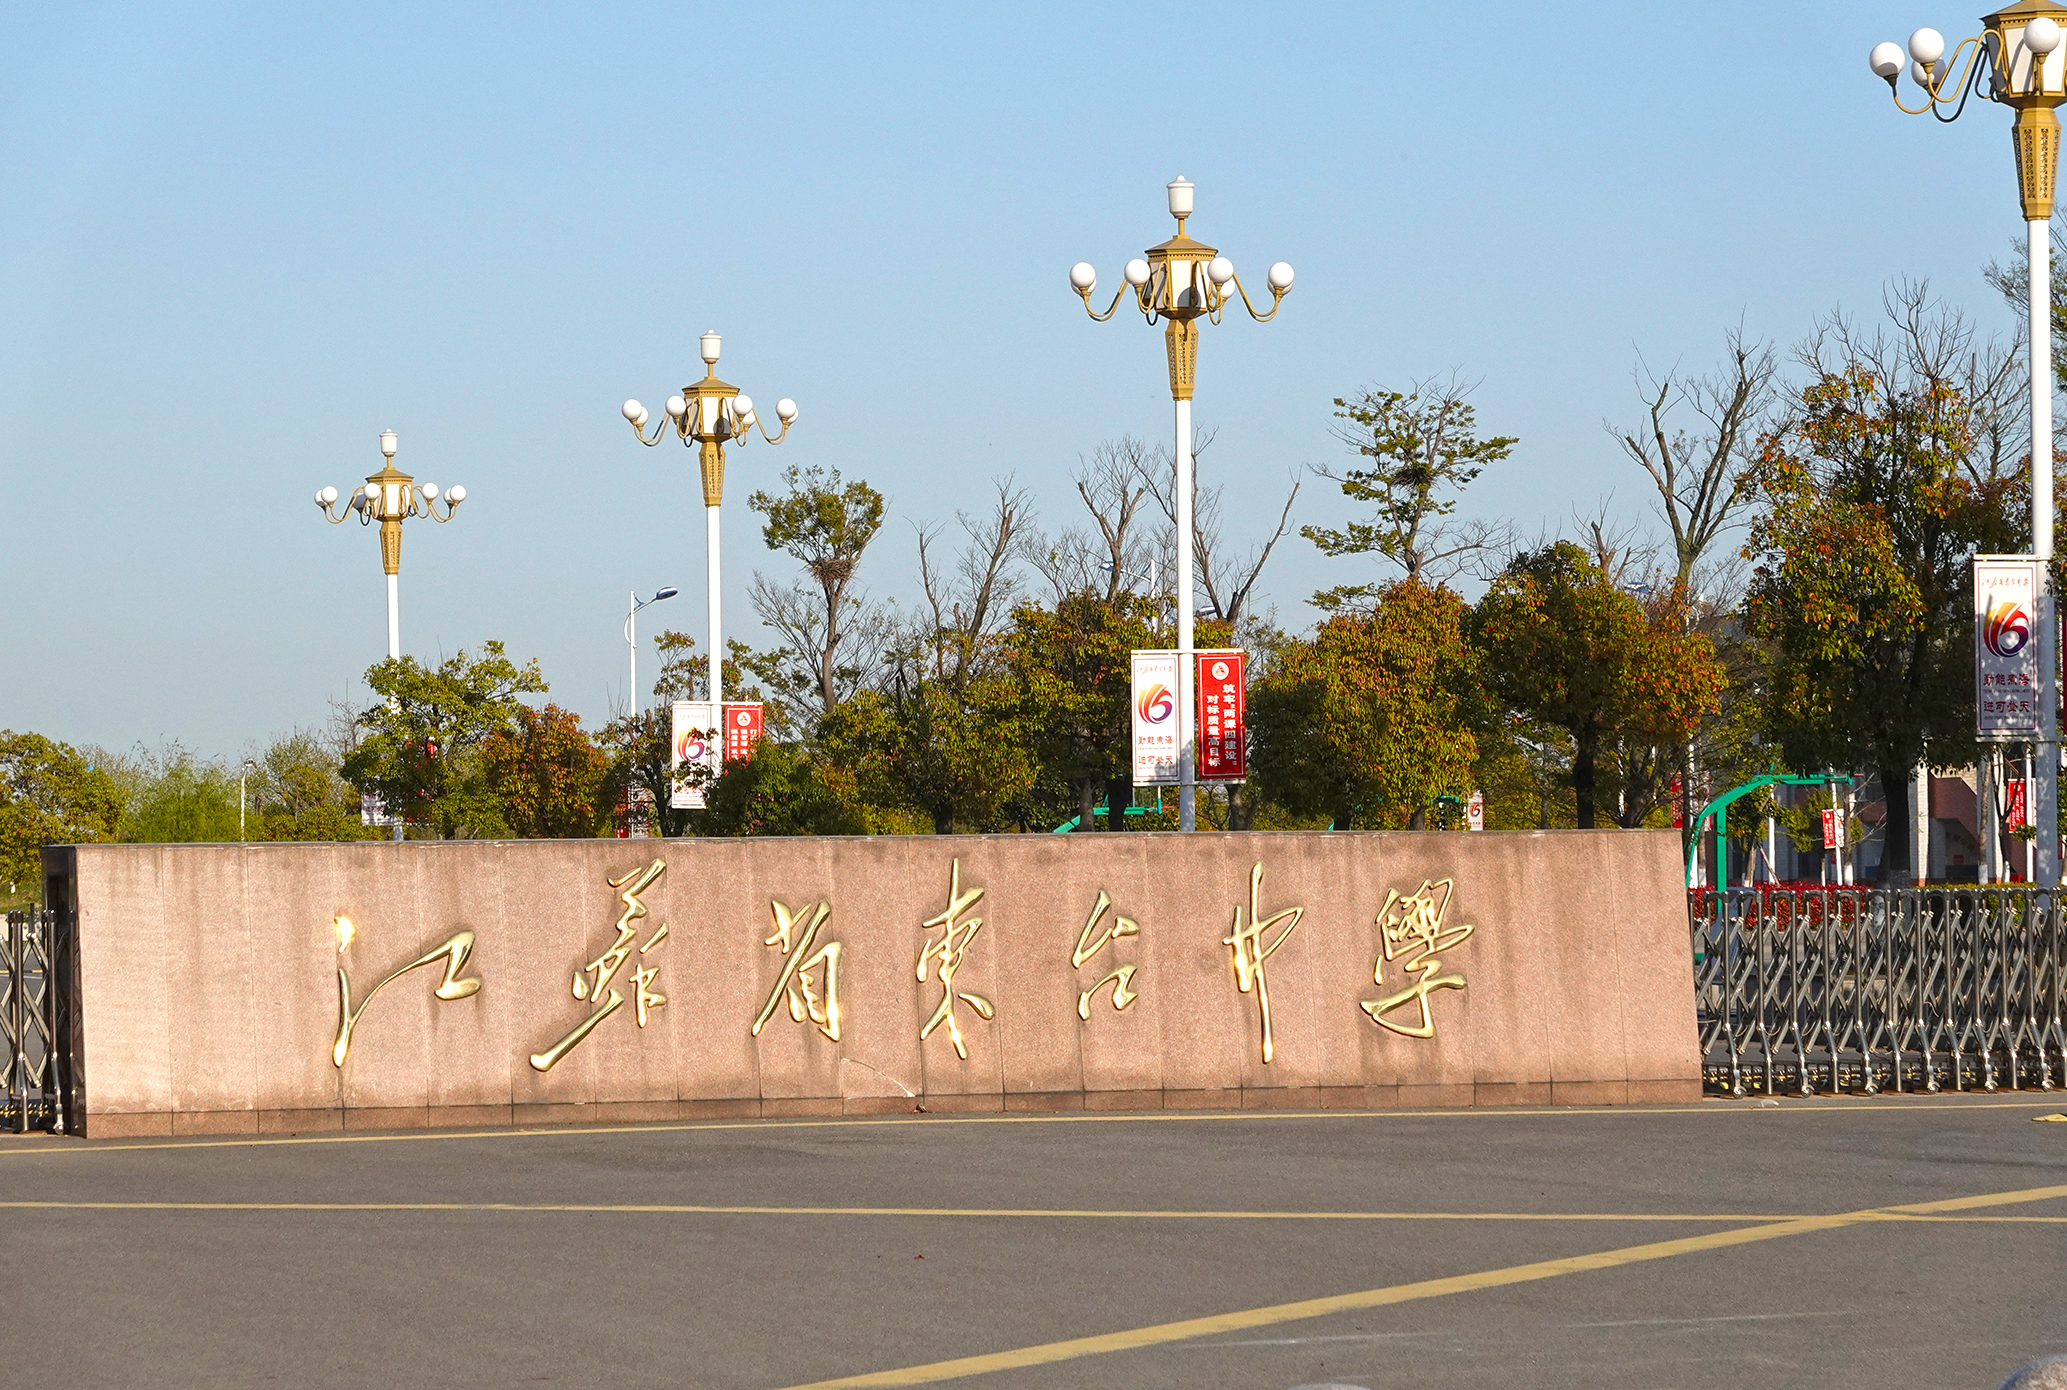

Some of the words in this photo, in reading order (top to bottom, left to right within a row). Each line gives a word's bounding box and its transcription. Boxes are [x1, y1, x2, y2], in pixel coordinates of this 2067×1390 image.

[1206, 695, 1221, 767] 对标质量高目标
